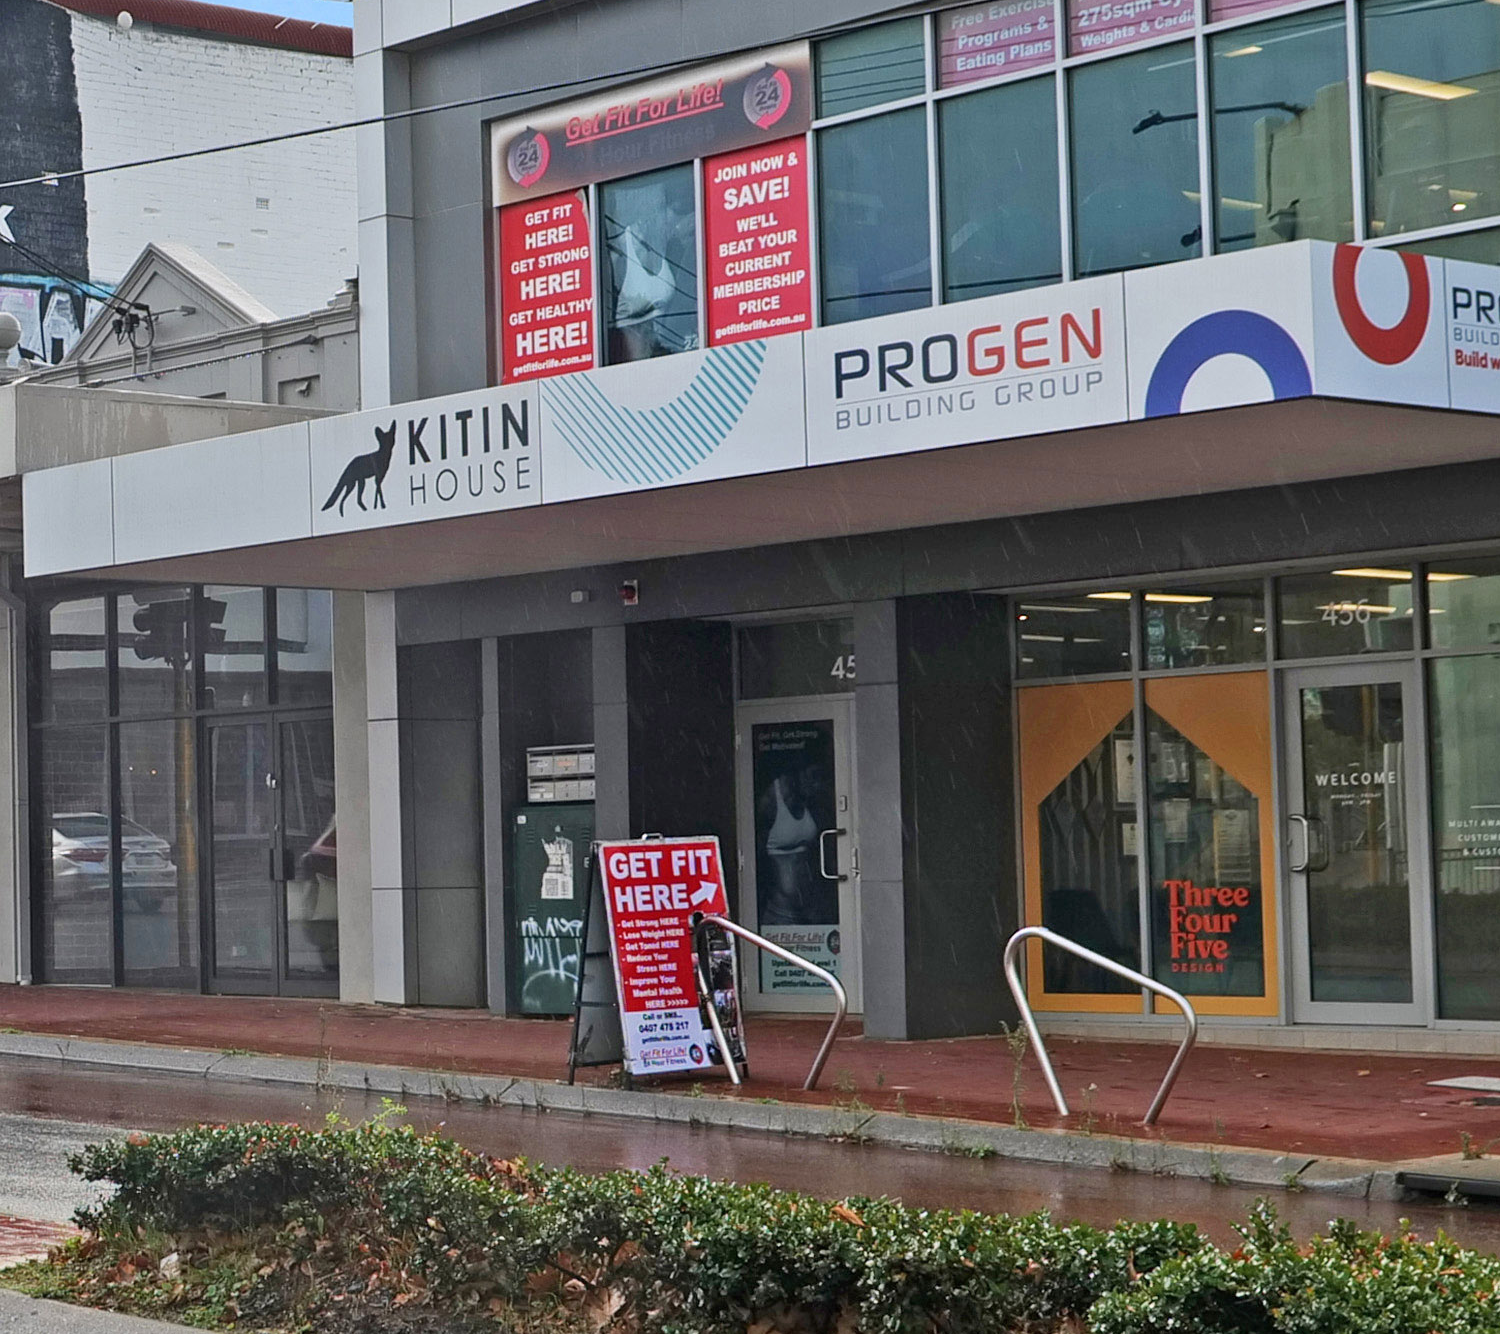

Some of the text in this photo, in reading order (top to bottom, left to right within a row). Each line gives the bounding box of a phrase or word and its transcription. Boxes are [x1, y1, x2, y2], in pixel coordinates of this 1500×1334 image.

[951, 10, 984, 29] Free
[958, 16, 1049, 50] Programs &
[1081, 22, 1150, 48] Weights &
[956, 40, 1052, 72] Eating Plans
[565, 78, 724, 140] Get Fit For Life!
[755, 87, 781, 105] 24
[518, 151, 539, 167] 24
[714, 152, 798, 183] JOIN NOW &
[724, 175, 790, 211] SAVE!
[525, 204, 572, 226] GET FIT
[736, 212, 778, 233] WE'LL
[525, 224, 574, 250] HERE!
[719, 229, 798, 257] BEAT YOUR
[511, 246, 589, 275] GET STRONG
[725, 251, 792, 277] CURRENT
[520, 269, 581, 301] HERE!
[713, 270, 805, 300] MEMBERSHIP
[509, 297, 594, 326] GET HEALTHY
[739, 295, 780, 315] PRICE
[516, 321, 588, 357] HERE!
[715, 313, 805, 339] getfitforlife.com.au
[513, 352, 592, 377] getfitforlife.com.au
[834, 308, 1102, 399] PROGEN
[1455, 349, 1488, 368] Build
[836, 371, 1103, 430] BUILDING GROUP
[407, 399, 529, 465] KITIN
[409, 456, 532, 506] HOUSE
[1321, 598, 1371, 626] 456
[831, 654, 856, 679] 45
[1315, 771, 1397, 787] WELCOME
[1448, 819, 1478, 828] MULTI
[609, 849, 712, 880] GET FIT
[614, 883, 690, 913] HERE
[1163, 879, 1250, 907] Three
[621, 917, 679, 928] Get Strong HERE
[666, 928, 684, 937] HERE
[1169, 906, 1238, 933] Four
[653, 953, 669, 961] Your
[661, 940, 679, 948] HERE
[1170, 932, 1229, 959] Five
[659, 963, 677, 971] HERE
[659, 976, 676, 984] Your
[1172, 963, 1225, 973] DESIGN
[645, 999, 666, 1008] HERE
